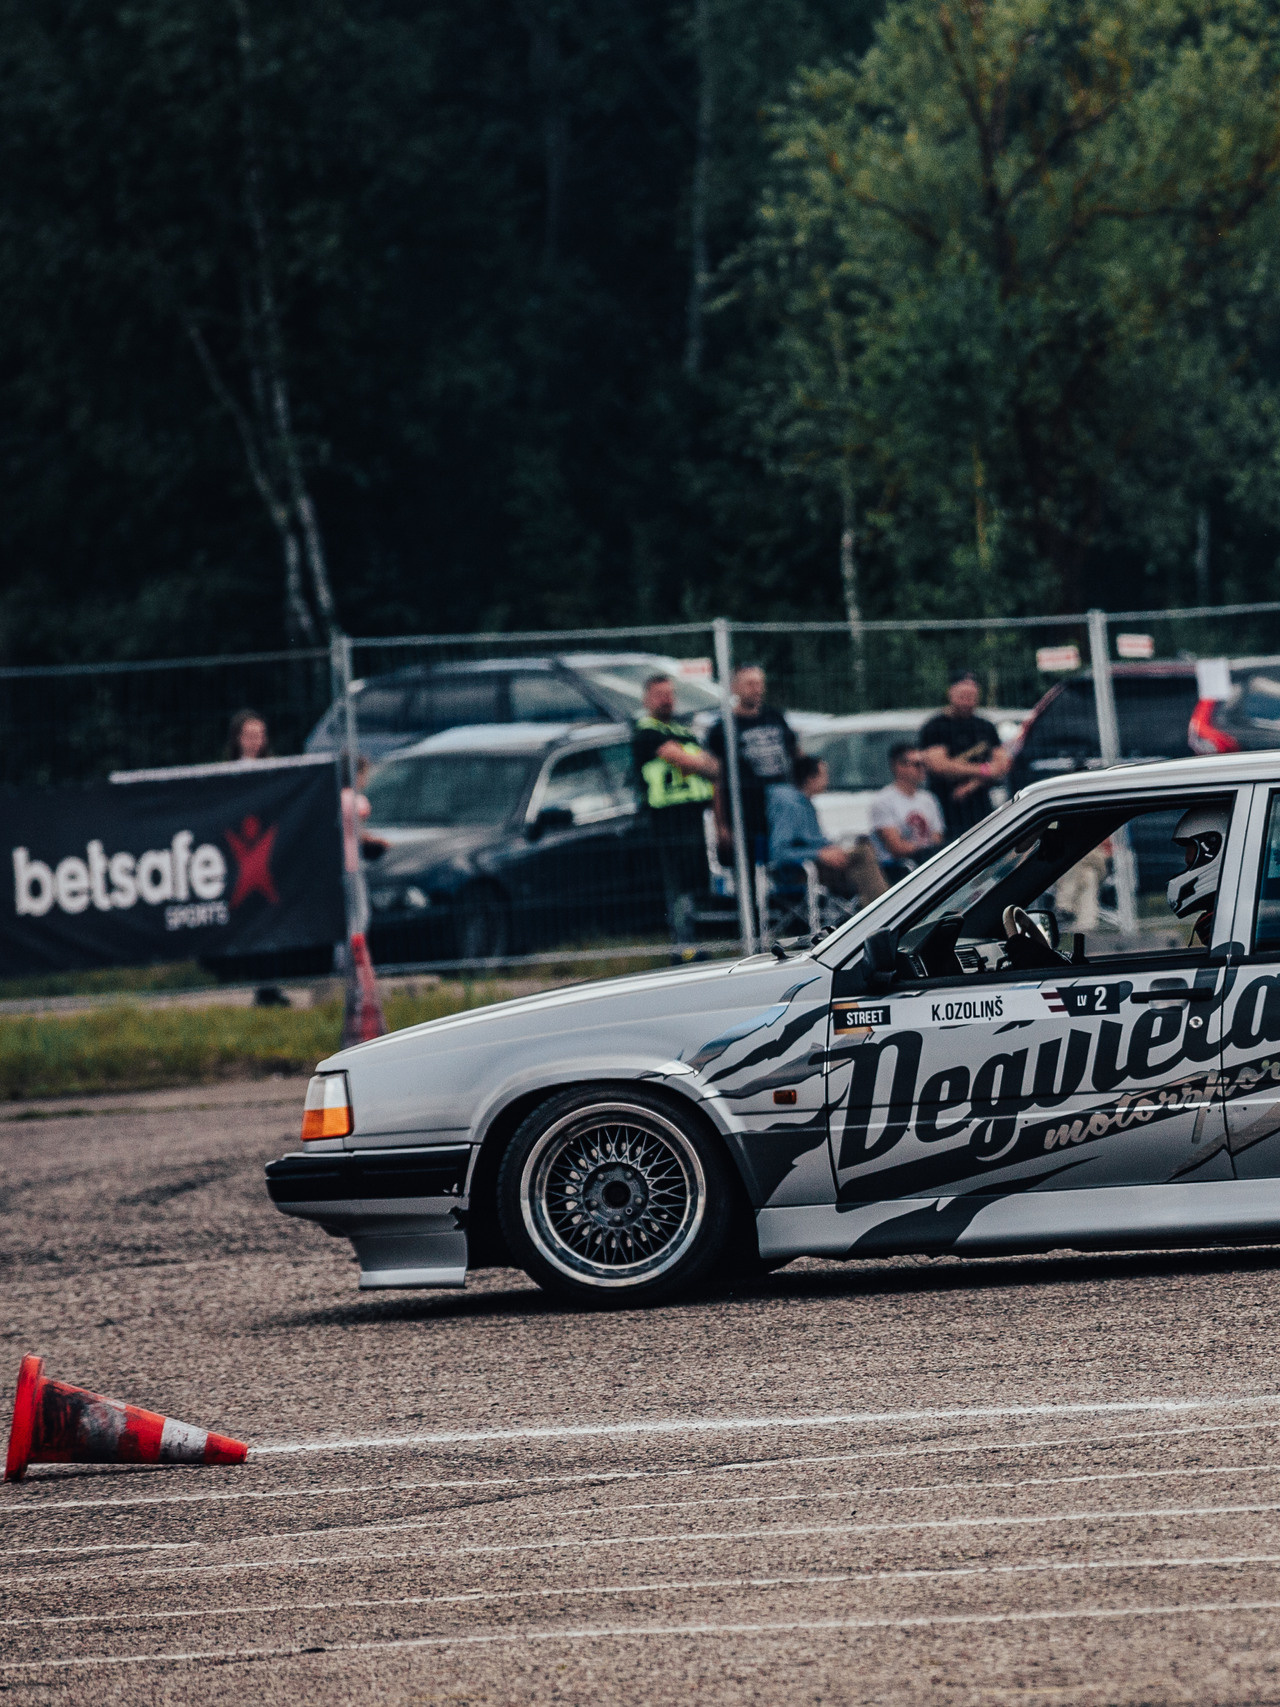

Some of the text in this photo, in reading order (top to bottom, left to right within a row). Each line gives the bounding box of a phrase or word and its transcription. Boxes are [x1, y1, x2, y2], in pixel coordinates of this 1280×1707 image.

[12, 829, 228, 917] betsafe
[931, 995, 1004, 1021] K.OZOLIŅŠ
[1076, 986, 1108, 1012] LV 2
[846, 1009, 884, 1026] STREET
